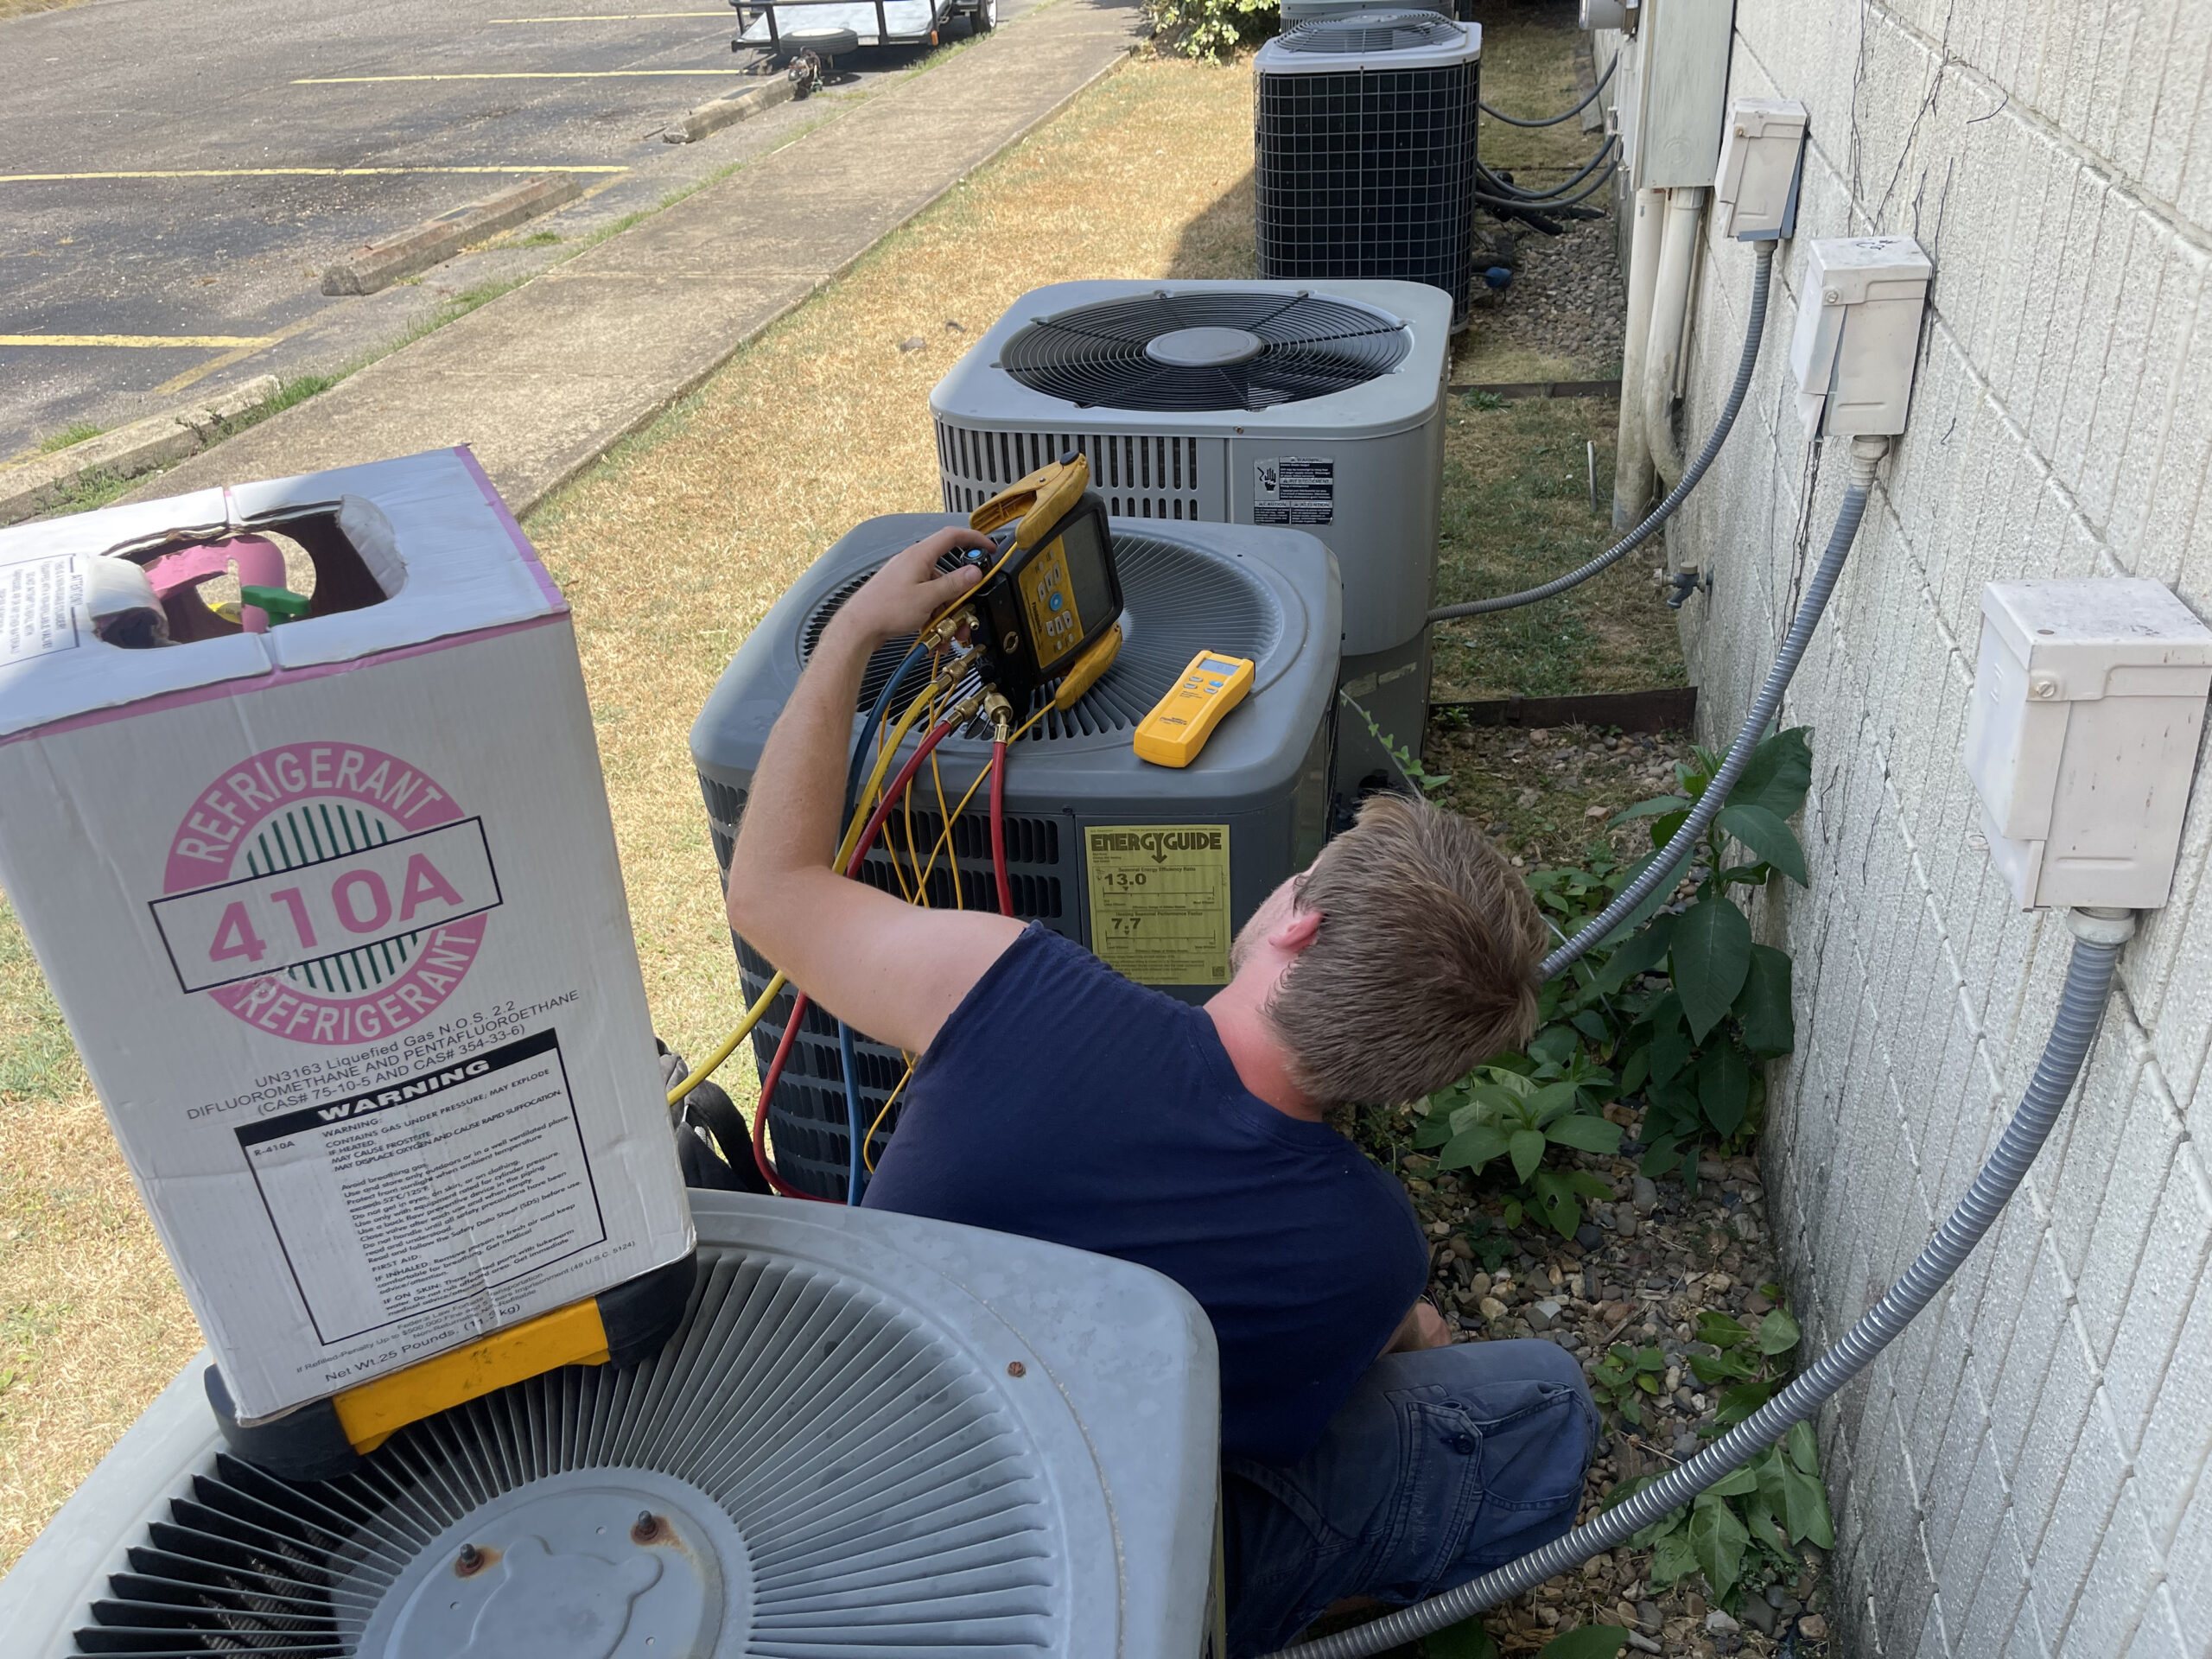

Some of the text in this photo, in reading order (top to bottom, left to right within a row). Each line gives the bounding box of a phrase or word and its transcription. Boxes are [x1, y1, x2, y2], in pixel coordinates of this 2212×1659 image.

[176, 748, 443, 863] REFRIGERANT
[208, 853, 465, 963] 410A
[1104, 873, 1147, 886] 13.0
[1111, 918, 1141, 930] 7.7
[233, 930, 478, 1042] REFRIGERANT
[186, 989, 579, 1120] DIFLUOROMETHANE AND PENTAFLUOROETHANE
[255, 1001, 515, 1088] UN3163 Liquefied Gas N.O.S. 2.2
[257, 1023, 524, 1116] (CAS# 75-10-5 AND CAS# 354-33-6)
[317, 1060, 489, 1121] WARNING
[321, 1118, 378, 1137] WARNING:
[325, 1068, 550, 1148] CONTAINS GAS UNDER PRESSURE; MAY EXPLODE
[253, 1141, 296, 1156] R-410A
[325, 1368, 352, 1382] Net
[354, 1350, 397, 1370] Wt.25
[401, 1330, 459, 1353] Pounds.
[499, 1303, 520, 1316] kg)
